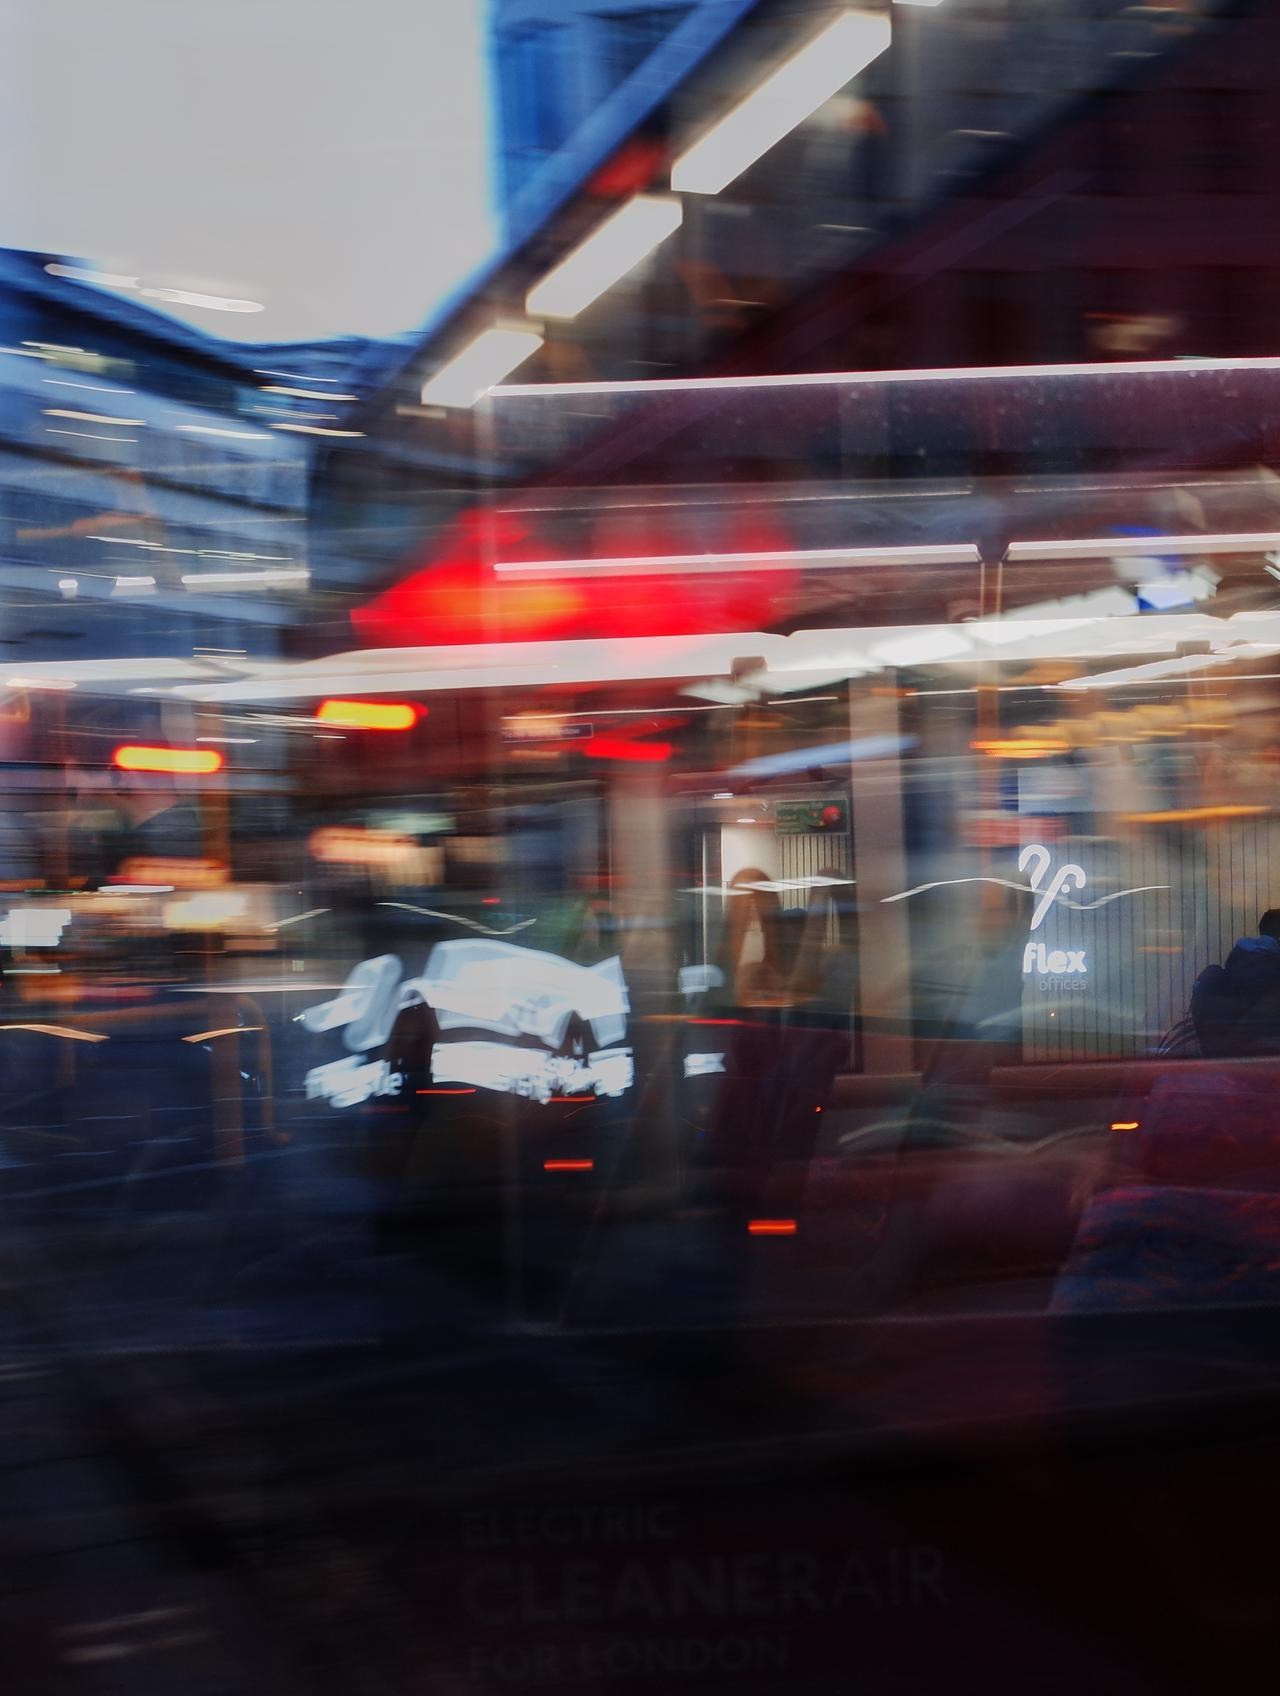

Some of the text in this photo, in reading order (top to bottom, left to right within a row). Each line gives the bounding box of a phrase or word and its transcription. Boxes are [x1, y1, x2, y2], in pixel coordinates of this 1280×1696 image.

[1023, 942, 1087, 974] flex
[1039, 975, 1087, 992] offices
[462, 1504, 679, 1545] ELECTRIC
[469, 1634, 790, 1682] FOR LONDON
